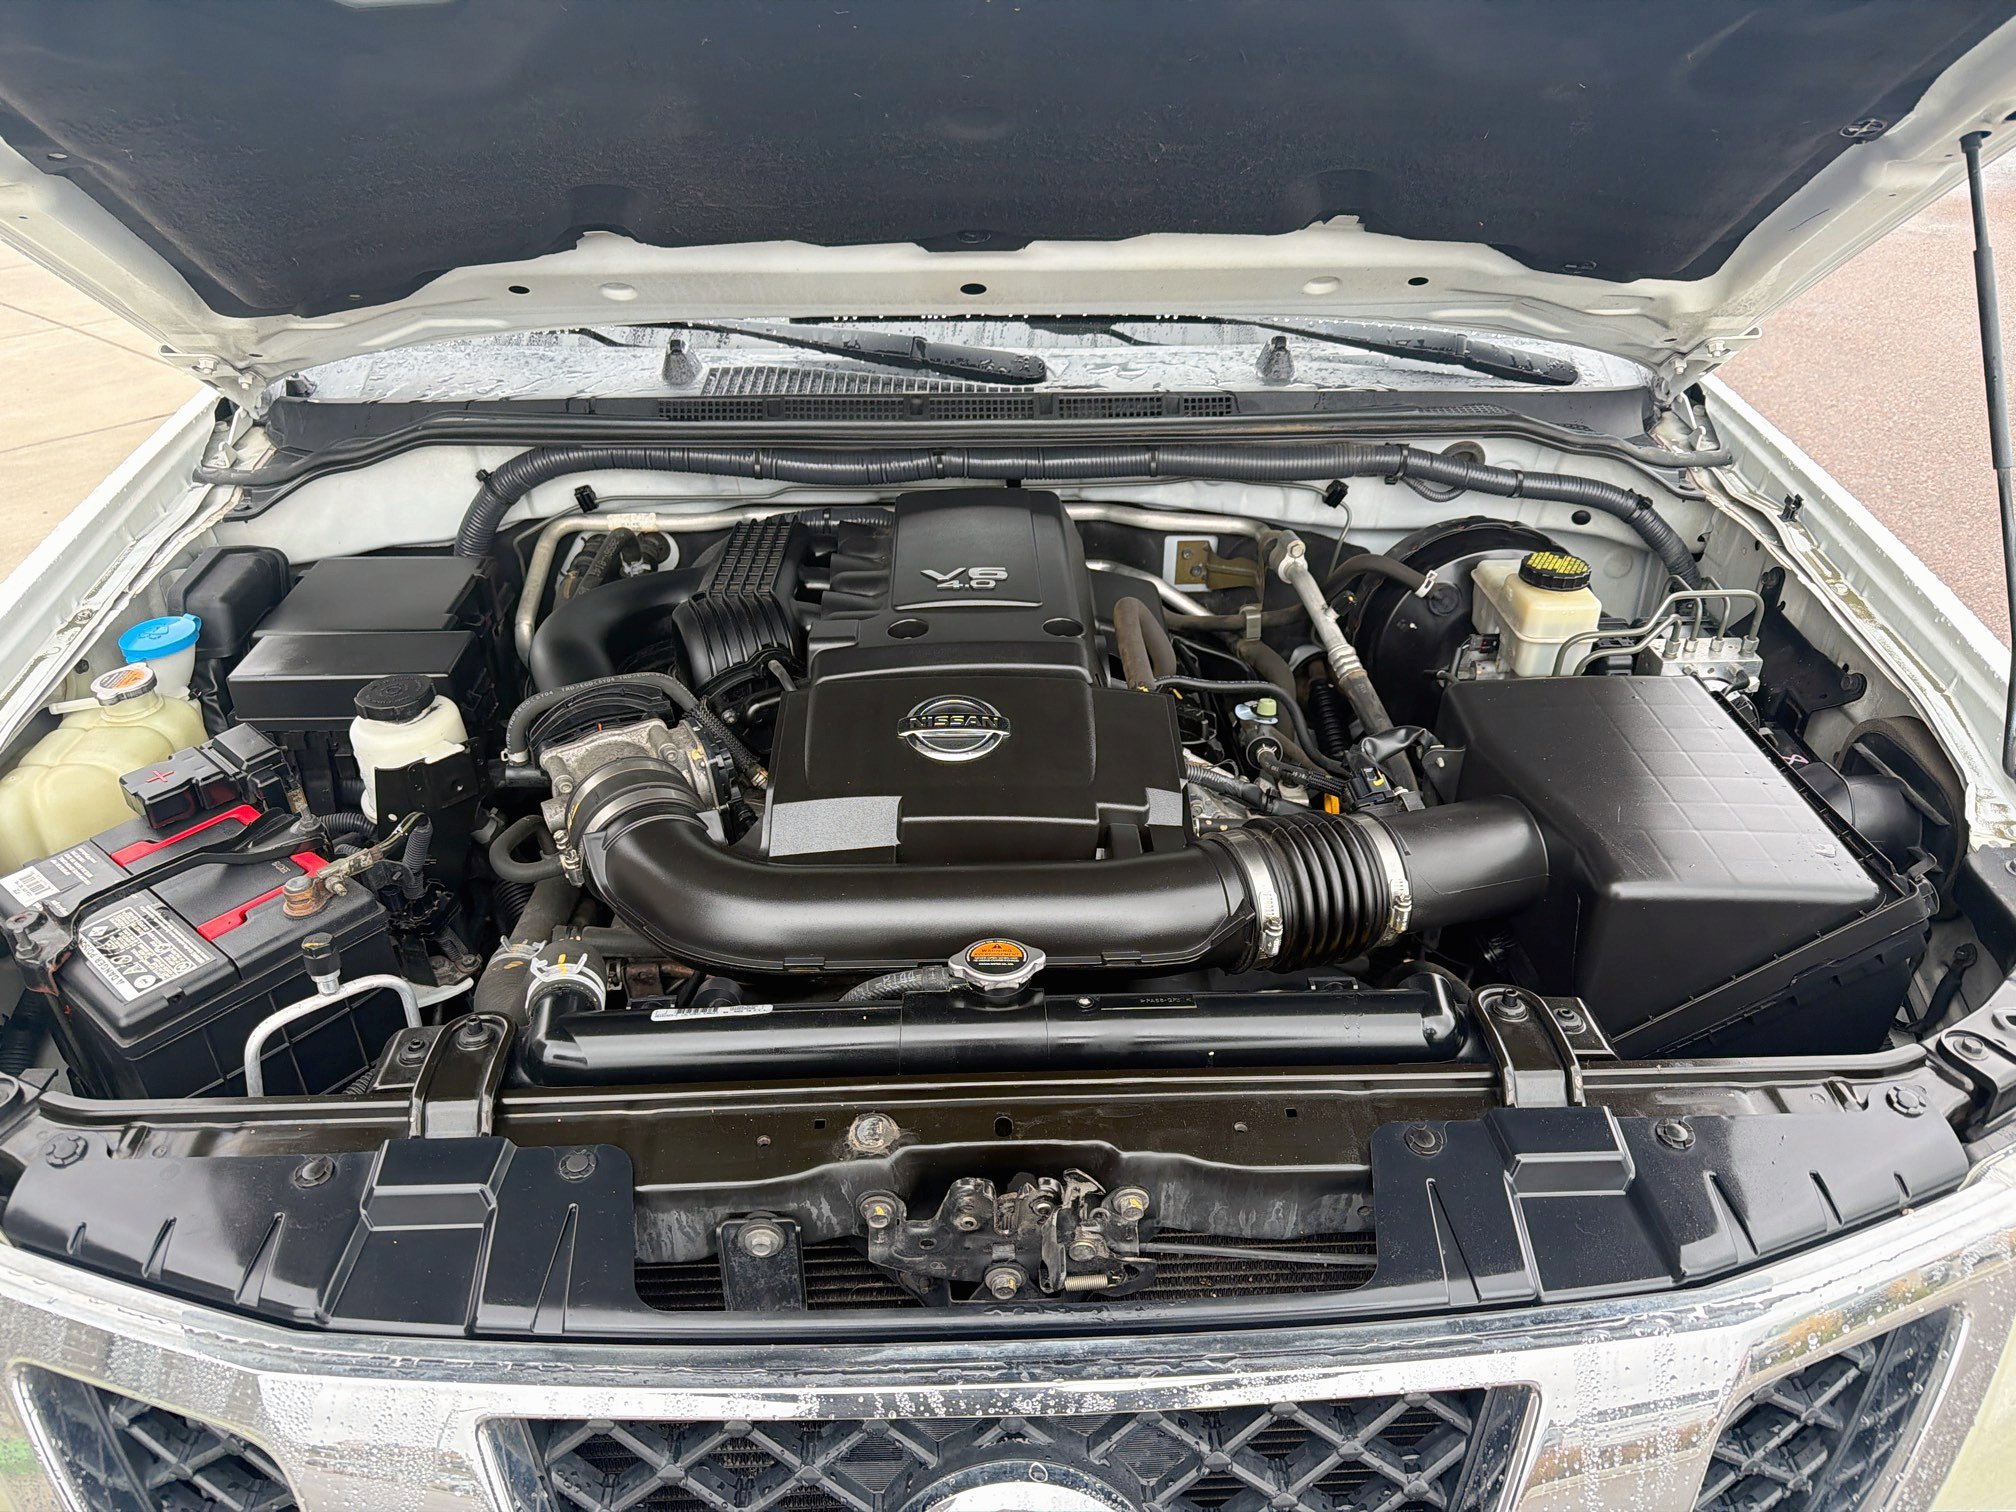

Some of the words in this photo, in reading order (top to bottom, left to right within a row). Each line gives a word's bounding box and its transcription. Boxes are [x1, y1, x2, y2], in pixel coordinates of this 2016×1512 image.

[920, 567, 1008, 582] V6
[937, 580, 996, 590] 4.0
[909, 715, 999, 730] NISSAN
[94, 956, 119, 981] DANGER
